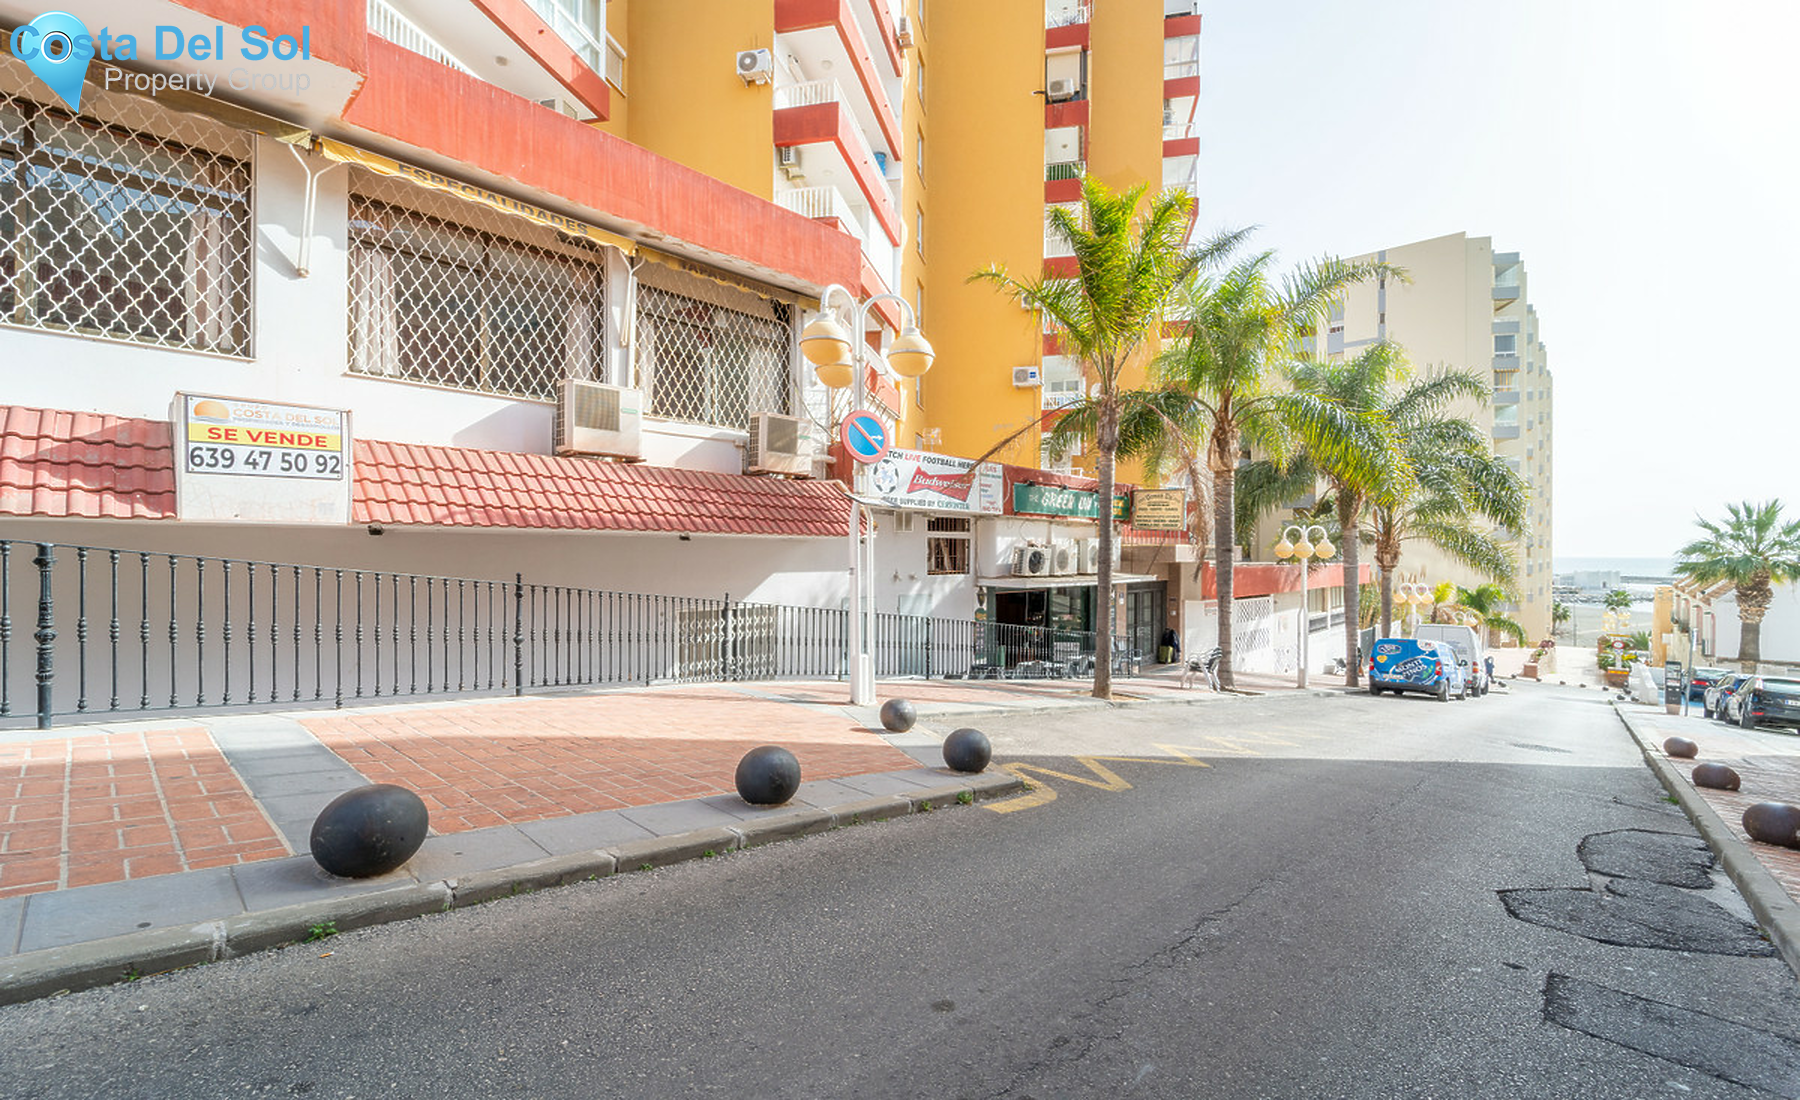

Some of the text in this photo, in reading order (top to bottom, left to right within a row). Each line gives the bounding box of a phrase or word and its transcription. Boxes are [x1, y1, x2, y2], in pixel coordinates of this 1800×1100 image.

[398, 164, 588, 236] ESPECIALIDADES
[233, 408, 338, 425] COSTA DEL SOL
[207, 427, 328, 448] SE VENDE
[190, 446, 341, 474] 639 47 50 92
[885, 450, 904, 460] TCH
[922, 456, 956, 468] FOOTBALL
[913, 474, 971, 489] Budweiser
[1041, 491, 1075, 509] GREEN
